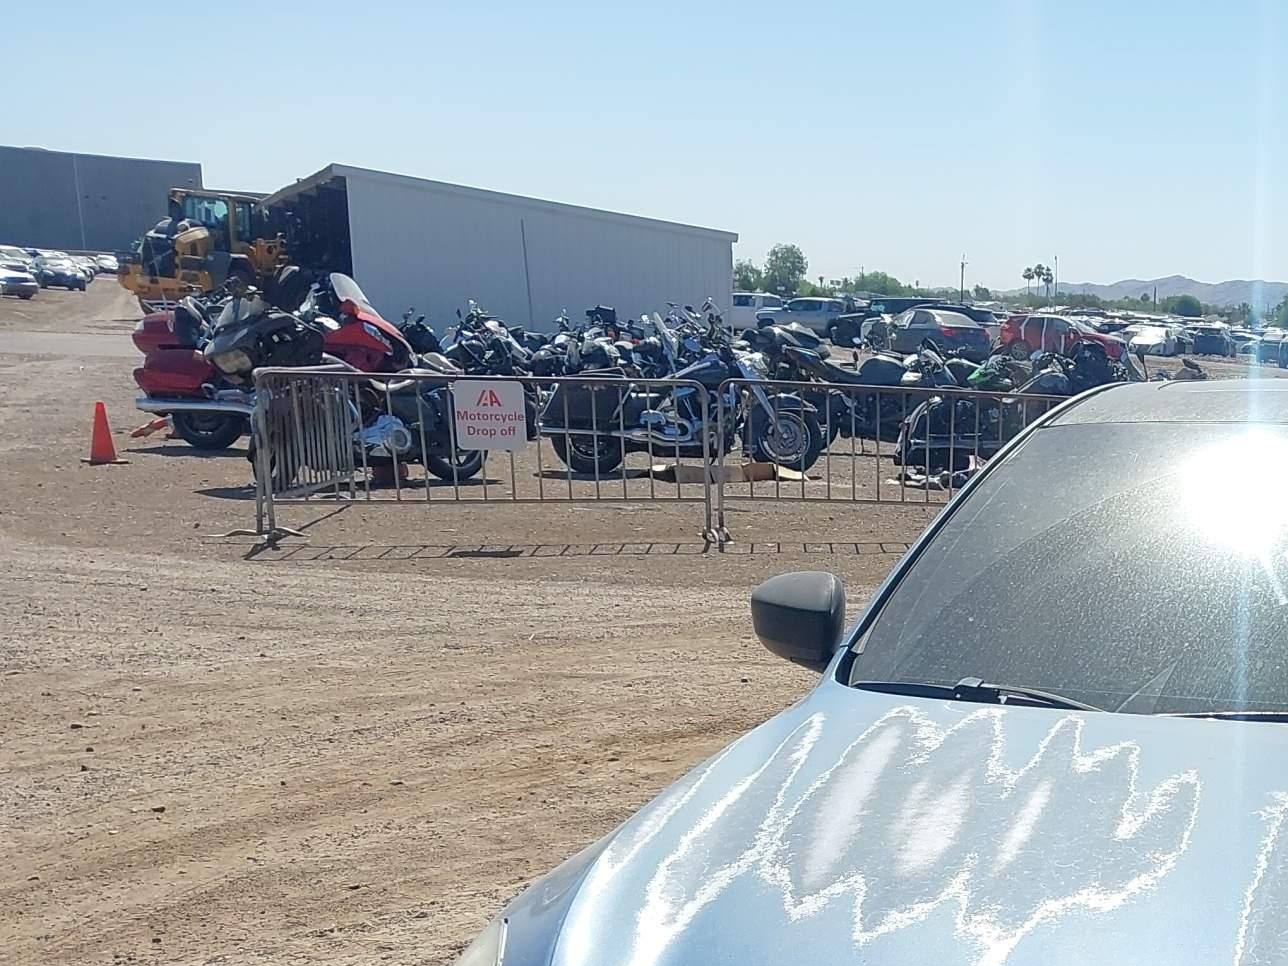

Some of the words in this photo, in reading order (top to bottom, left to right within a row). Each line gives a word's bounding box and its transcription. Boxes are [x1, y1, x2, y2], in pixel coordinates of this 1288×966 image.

[456, 410, 524, 422] Motorcycle
[467, 426, 497, 438] Drop
[501, 426, 516, 436] off
